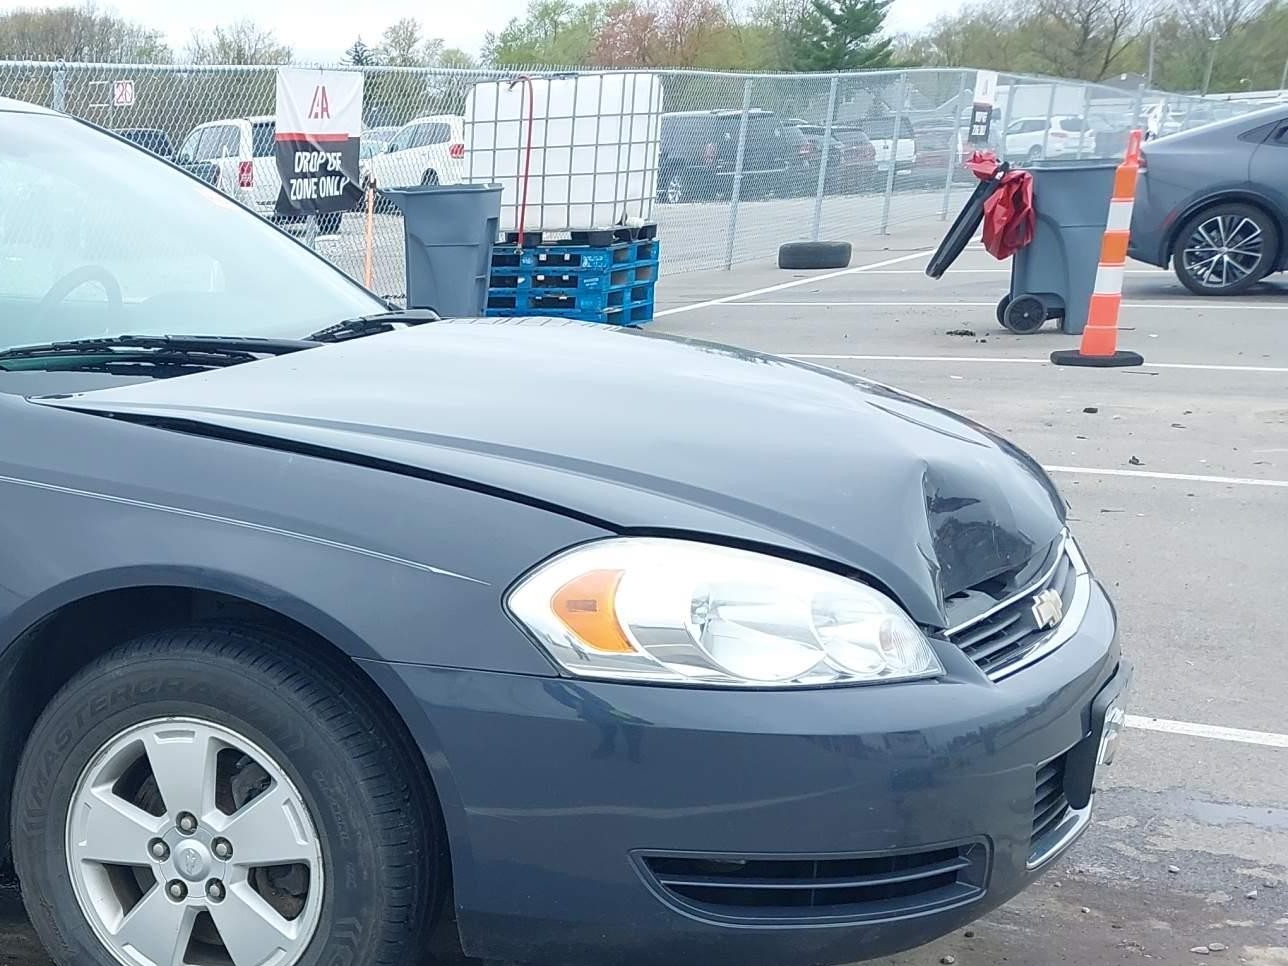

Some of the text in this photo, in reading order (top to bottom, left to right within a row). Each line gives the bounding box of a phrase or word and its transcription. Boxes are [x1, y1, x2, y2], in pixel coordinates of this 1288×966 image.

[294, 151, 326, 173] DROP
[289, 175, 351, 201] ZONE ONLY
